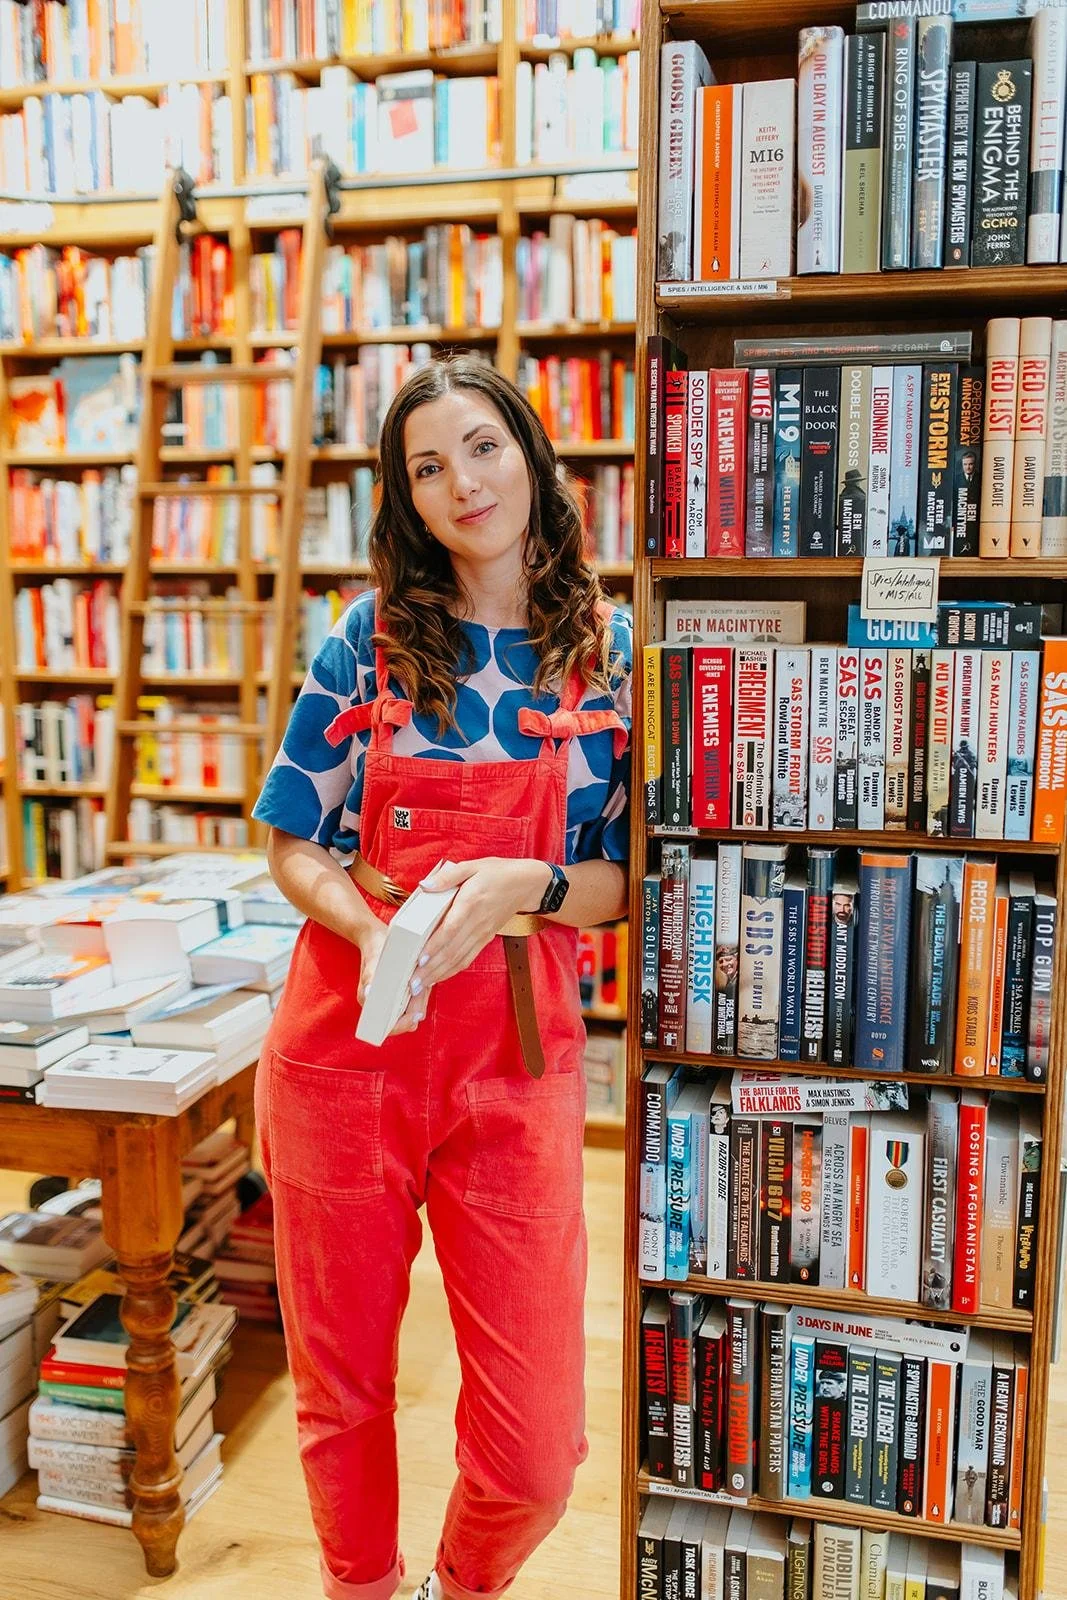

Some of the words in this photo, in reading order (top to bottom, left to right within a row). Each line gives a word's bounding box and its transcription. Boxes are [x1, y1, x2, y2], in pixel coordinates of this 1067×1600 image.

[869, 0, 951, 19] COMMANDO
[895, 48, 908, 84] RING
[670, 54, 685, 114] GOOSE
[895, 90, 908, 110] OF
[755, 134, 779, 142] JEFFERY
[759, 126, 776, 134] KEITH
[893, 115, 906, 151] SPIES
[917, 68, 947, 181] SPYMASTER
[1005, 105, 1022, 166] BEHIND
[669, 119, 684, 180] GREEN
[750, 149, 784, 164] MI6
[981, 106, 1004, 203] ENIGMA
[1004, 170, 1019, 201] THE
[981, 217, 1018, 229] GCHQ
[988, 233, 1010, 242] JOHN
[987, 241, 1011, 250] FERRIS
[991, 360, 1015, 392] RED
[691, 379, 704, 437] SOLDIER
[850, 370, 861, 419] DOUBLE
[778, 384, 800, 442] MI9
[805, 422, 837, 430] DOOR
[872, 387, 889, 454] LEGIONNAIRE
[960, 378, 972, 446] MINCEMEAT
[989, 399, 1013, 435] LIST
[848, 423, 860, 466] CROSS
[928, 397, 950, 469] STORM
[690, 442, 703, 468] SPY
[993, 456, 1005, 480] DAVID
[871, 465, 879, 493] MURRAY
[992, 482, 1004, 507] CAUTE
[688, 499, 696, 536] MARCUS
[842, 499, 852, 544] MACINTYRE
[852, 514, 862, 529] BEN
[936, 499, 944, 524] PETER
[957, 488, 967, 537] MACINTYRE
[967, 503, 976, 521] BEN
[677, 618, 701, 632] BEN
[707, 619, 782, 632] MACINTYRE
[740, 663, 759, 671] THE
[819, 657, 829, 674] BEN
[839, 656, 856, 698] SAS
[864, 658, 882, 700] SAS
[895, 657, 904, 679] SAS
[991, 660, 1000, 681] SAS
[738, 671, 767, 740] REGIMENT
[791, 678, 802, 701] SAS
[818, 677, 828, 728] MACINTYRE
[894, 682, 903, 715] GHOST
[990, 684, 1000, 709] NAZI
[778, 697, 789, 744] Rowland
[790, 706, 802, 749] STORM
[839, 700, 847, 741] ESCAPES
[736, 744, 744, 759] the
[756, 742, 764, 760] The
[816, 736, 832, 764] SAS
[872, 732, 880, 743] OF
[893, 718, 903, 756] PATROL
[987, 713, 999, 763] HUNTERS
[736, 761, 744, 780] SAS
[778, 748, 789, 779] White
[789, 755, 800, 795] FRONT
[745, 774, 753, 800] Story
[755, 762, 764, 805] Definitive
[745, 802, 753, 811] of
[663, 892, 673, 912] NAZI
[673, 884, 684, 900] THE
[969, 880, 987, 923] RECCE
[694, 884, 713, 945] HIGH
[788, 906, 797, 924] THE
[935, 904, 946, 924] THE
[1036, 912, 1054, 947] TOP
[662, 915, 672, 951] HUNTER
[672, 902, 683, 960] UNDERCOVER
[745, 911, 774, 956] SBS
[788, 926, 797, 942] SBS
[645, 926, 656, 981] SOLDIER
[788, 945, 796, 956] IN
[933, 927, 945, 968] DEADLY
[693, 950, 712, 1004] RISK
[787, 958, 796, 993] WORLD
[931, 972, 943, 1005] TRADE
[1033, 956, 1051, 993] GUN
[786, 996, 795, 1016] WAR
[739, 1088, 750, 1096] THE
[753, 1087, 774, 1096] BATTLE
[775, 1087, 787, 1095] FOR
[788, 1087, 799, 1095] THE
[740, 1095, 801, 1112] FALKLANDS
[808, 1090, 822, 1098] MAX
[822, 1089, 851, 1097] HASTINGS
[645, 1093, 662, 1162] COMMANDO
[824, 1116, 848, 1126] DELVES
[718, 1141, 727, 1178] RAZOR'S
[833, 1144, 845, 1180] ACROSS
[968, 1124, 980, 1177] LOSING
[718, 1178, 726, 1201] EDGE
[833, 1182, 844, 1195] AN
[933, 1157, 948, 1194] FIRST
[998, 1155, 1010, 1205] Unwinnable
[1026, 1182, 1034, 1192] JOE
[831, 1197, 843, 1229] ANGRY
[1024, 1193, 1033, 1218] GLENTON
[642, 1230, 650, 1255] HALLS
[650, 1228, 658, 1258] MONTY
[831, 1231, 842, 1247] SEA
[930, 1197, 947, 1263] CASUALTY
[965, 1184, 978, 1283] AFGHANISTAN
[732, 1317, 743, 1339] MIKE
[771, 1329, 783, 1348] THE
[797, 1316, 803, 1326] 3
[805, 1318, 831, 1331] DAYS
[833, 1323, 844, 1333] IN
[845, 1325, 872, 1338] JUNE
[644, 1330, 666, 1395] AFGANTSY
[732, 1341, 742, 1375] SUTTON
[770, 1354, 782, 1428] AFGHANISTAN
[852, 1374, 869, 1394] THE
[878, 1379, 896, 1399] THE
[905, 1369, 921, 1416] SPYMASTER
[58, 1417, 105, 1428] VICTORY
[851, 1395, 868, 1437] LEDGER
[877, 1401, 894, 1444] LEDGER
[769, 1433, 780, 1473] PAPERS
[904, 1421, 918, 1460] BAGHDAD
[991, 1469, 999, 1500] MAYHEW
[997, 1475, 1005, 1496] EMILY
[686, 1547, 695, 1570] TASK
[794, 1550, 805, 1599] LIGHTING
[869, 1544, 881, 1599] Chemical
[684, 1571, 695, 1598] FORCE
